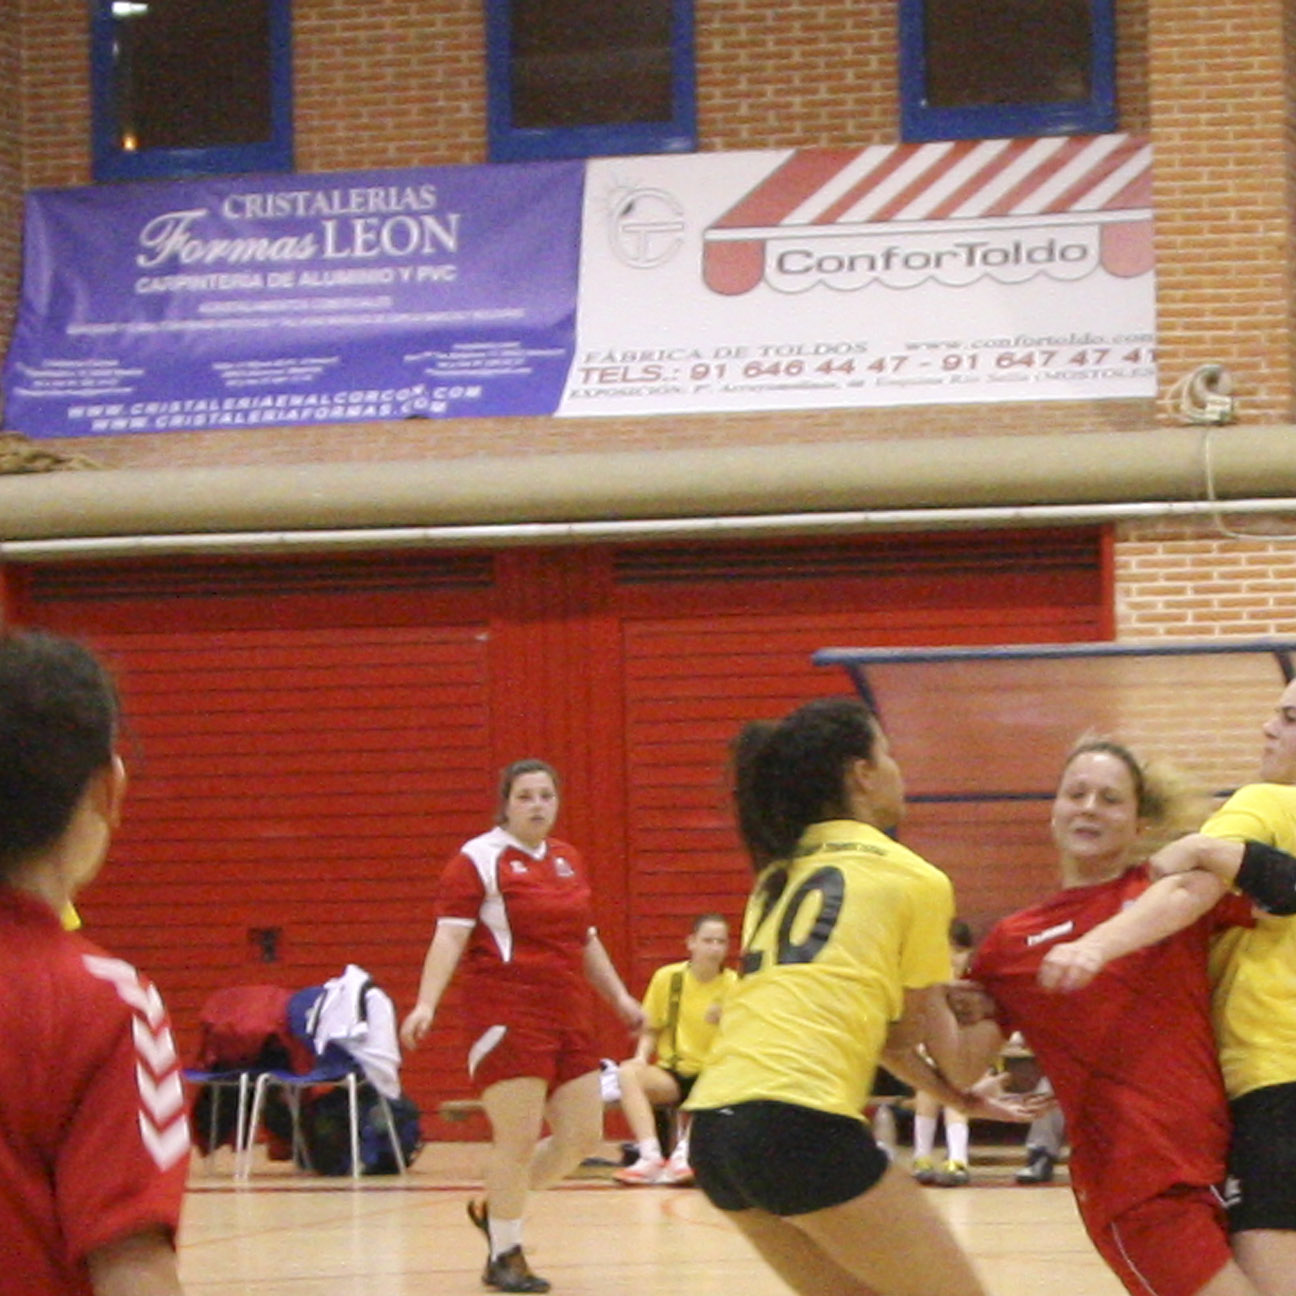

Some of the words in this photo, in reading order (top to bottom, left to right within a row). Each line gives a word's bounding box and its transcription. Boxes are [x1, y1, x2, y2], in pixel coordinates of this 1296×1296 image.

[223, 184, 437, 219] CRISTALERIAS
[136, 208, 319, 268] Formas
[321, 213, 461, 260] LEON
[776, 239, 1089, 275] ConforToldo
[267, 270, 295, 289] DE
[398, 265, 413, 284] Y
[416, 263, 458, 283] PVC
[689, 363, 727, 380] 91
[742, 360, 805, 378] 646
[815, 358, 856, 375] 44
[867, 355, 909, 373] 47
[941, 353, 979, 371] 91
[995, 350, 1059, 369] 647
[1069, 348, 1110, 367] 47
[713, 346, 751, 360] DE
[759, 341, 869, 356] TOLDOS
[736, 865, 845, 979] 20
